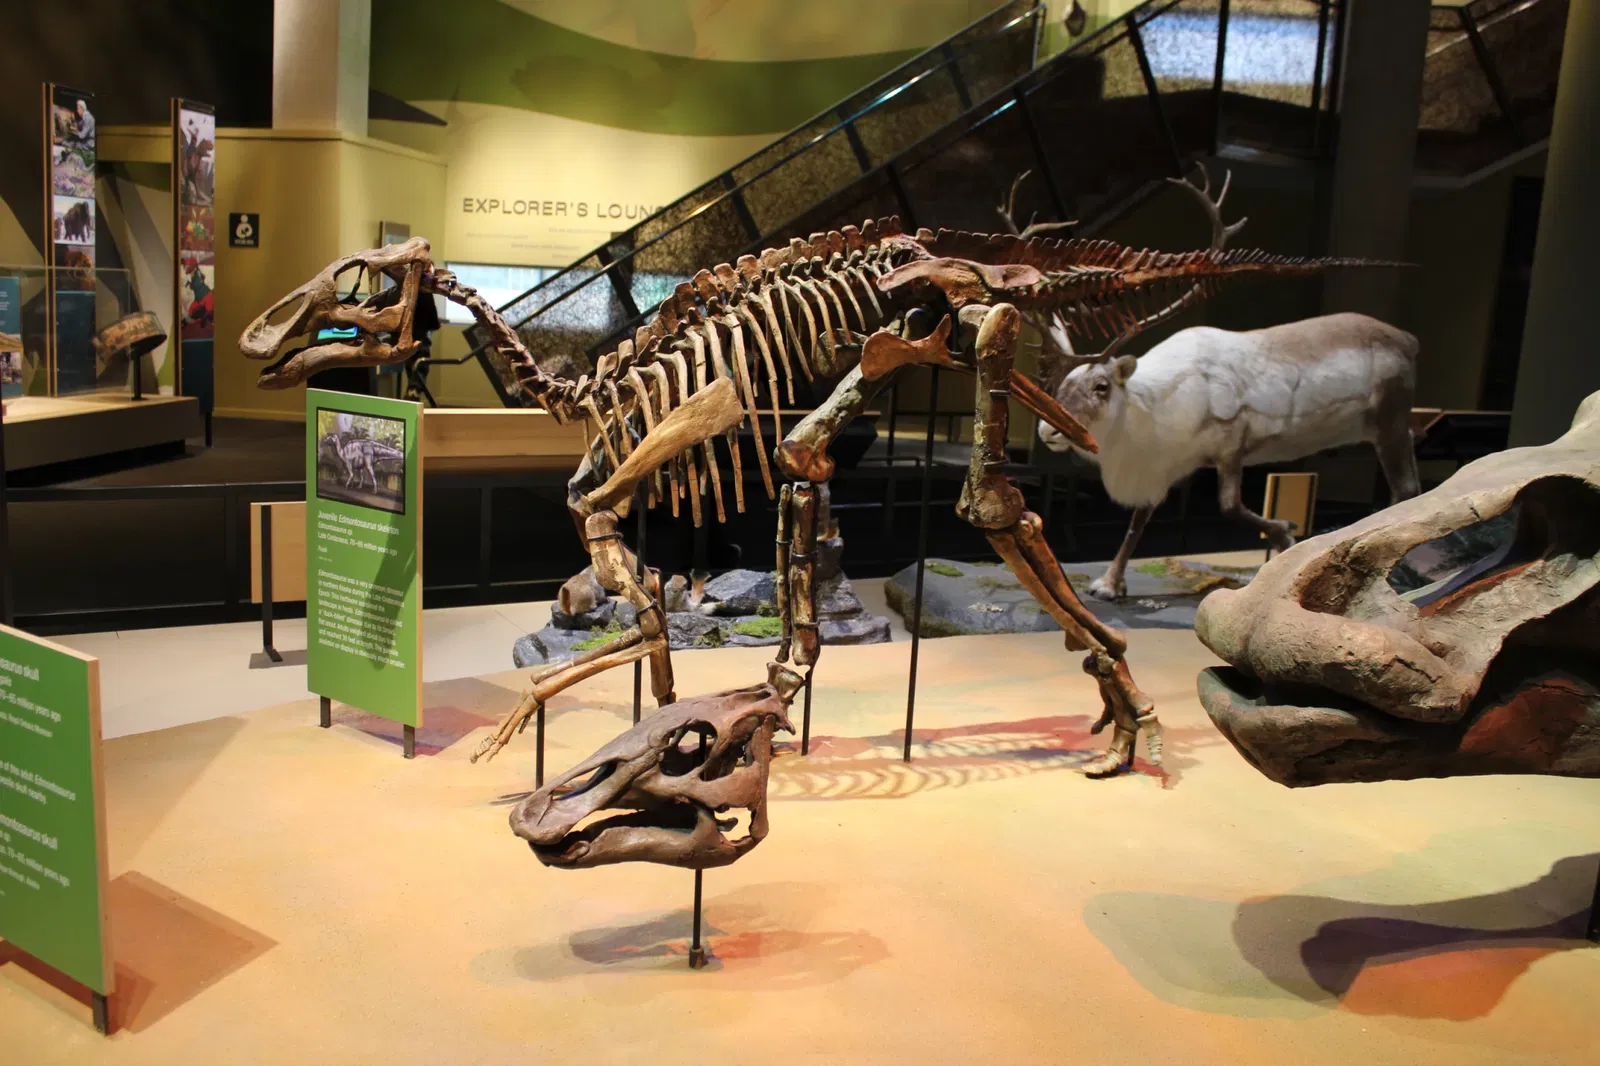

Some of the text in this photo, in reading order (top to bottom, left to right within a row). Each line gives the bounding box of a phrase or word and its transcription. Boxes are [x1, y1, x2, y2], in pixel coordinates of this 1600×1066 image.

[463, 198, 588, 217] EXPLORER'S
[339, 515, 376, 529] Edmontosaurus
[377, 524, 399, 534] skeleton
